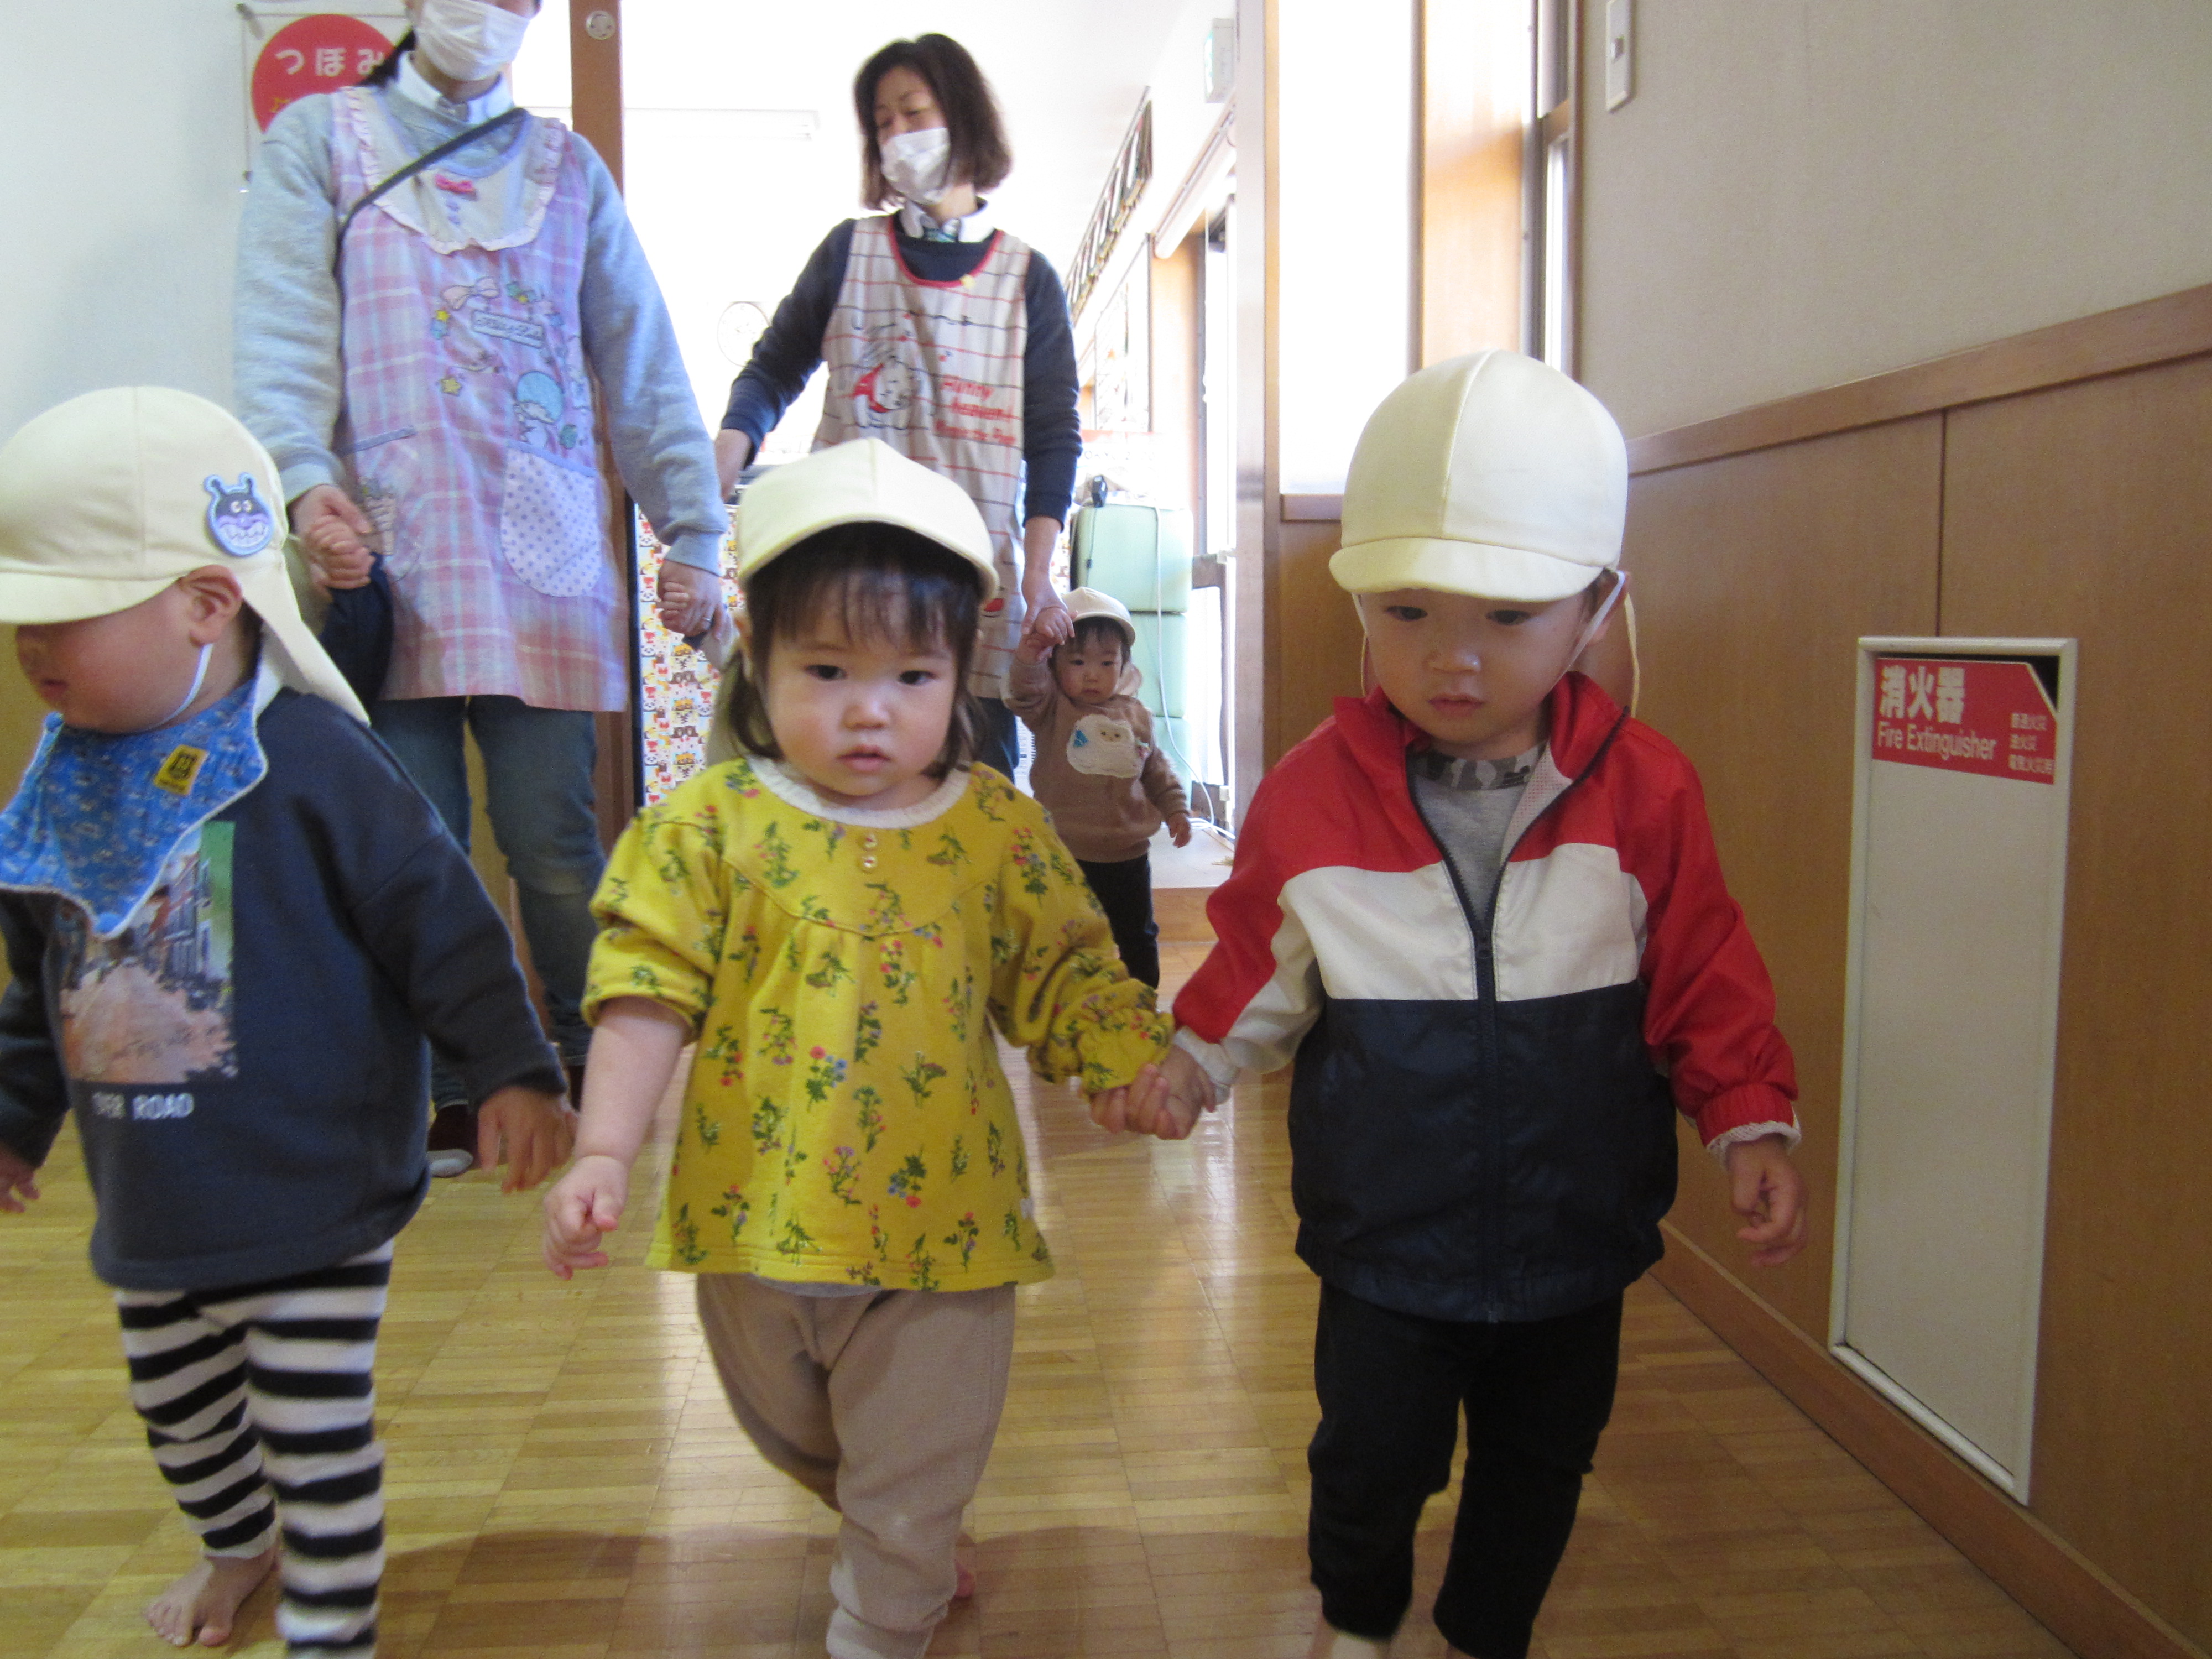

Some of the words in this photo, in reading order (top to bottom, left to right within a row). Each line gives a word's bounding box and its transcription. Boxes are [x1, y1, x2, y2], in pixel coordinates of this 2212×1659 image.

[1879, 665, 1965, 724] 消火器
[1877, 721, 1903, 749] Fire
[1906, 723, 1997, 761] Extinguisher
